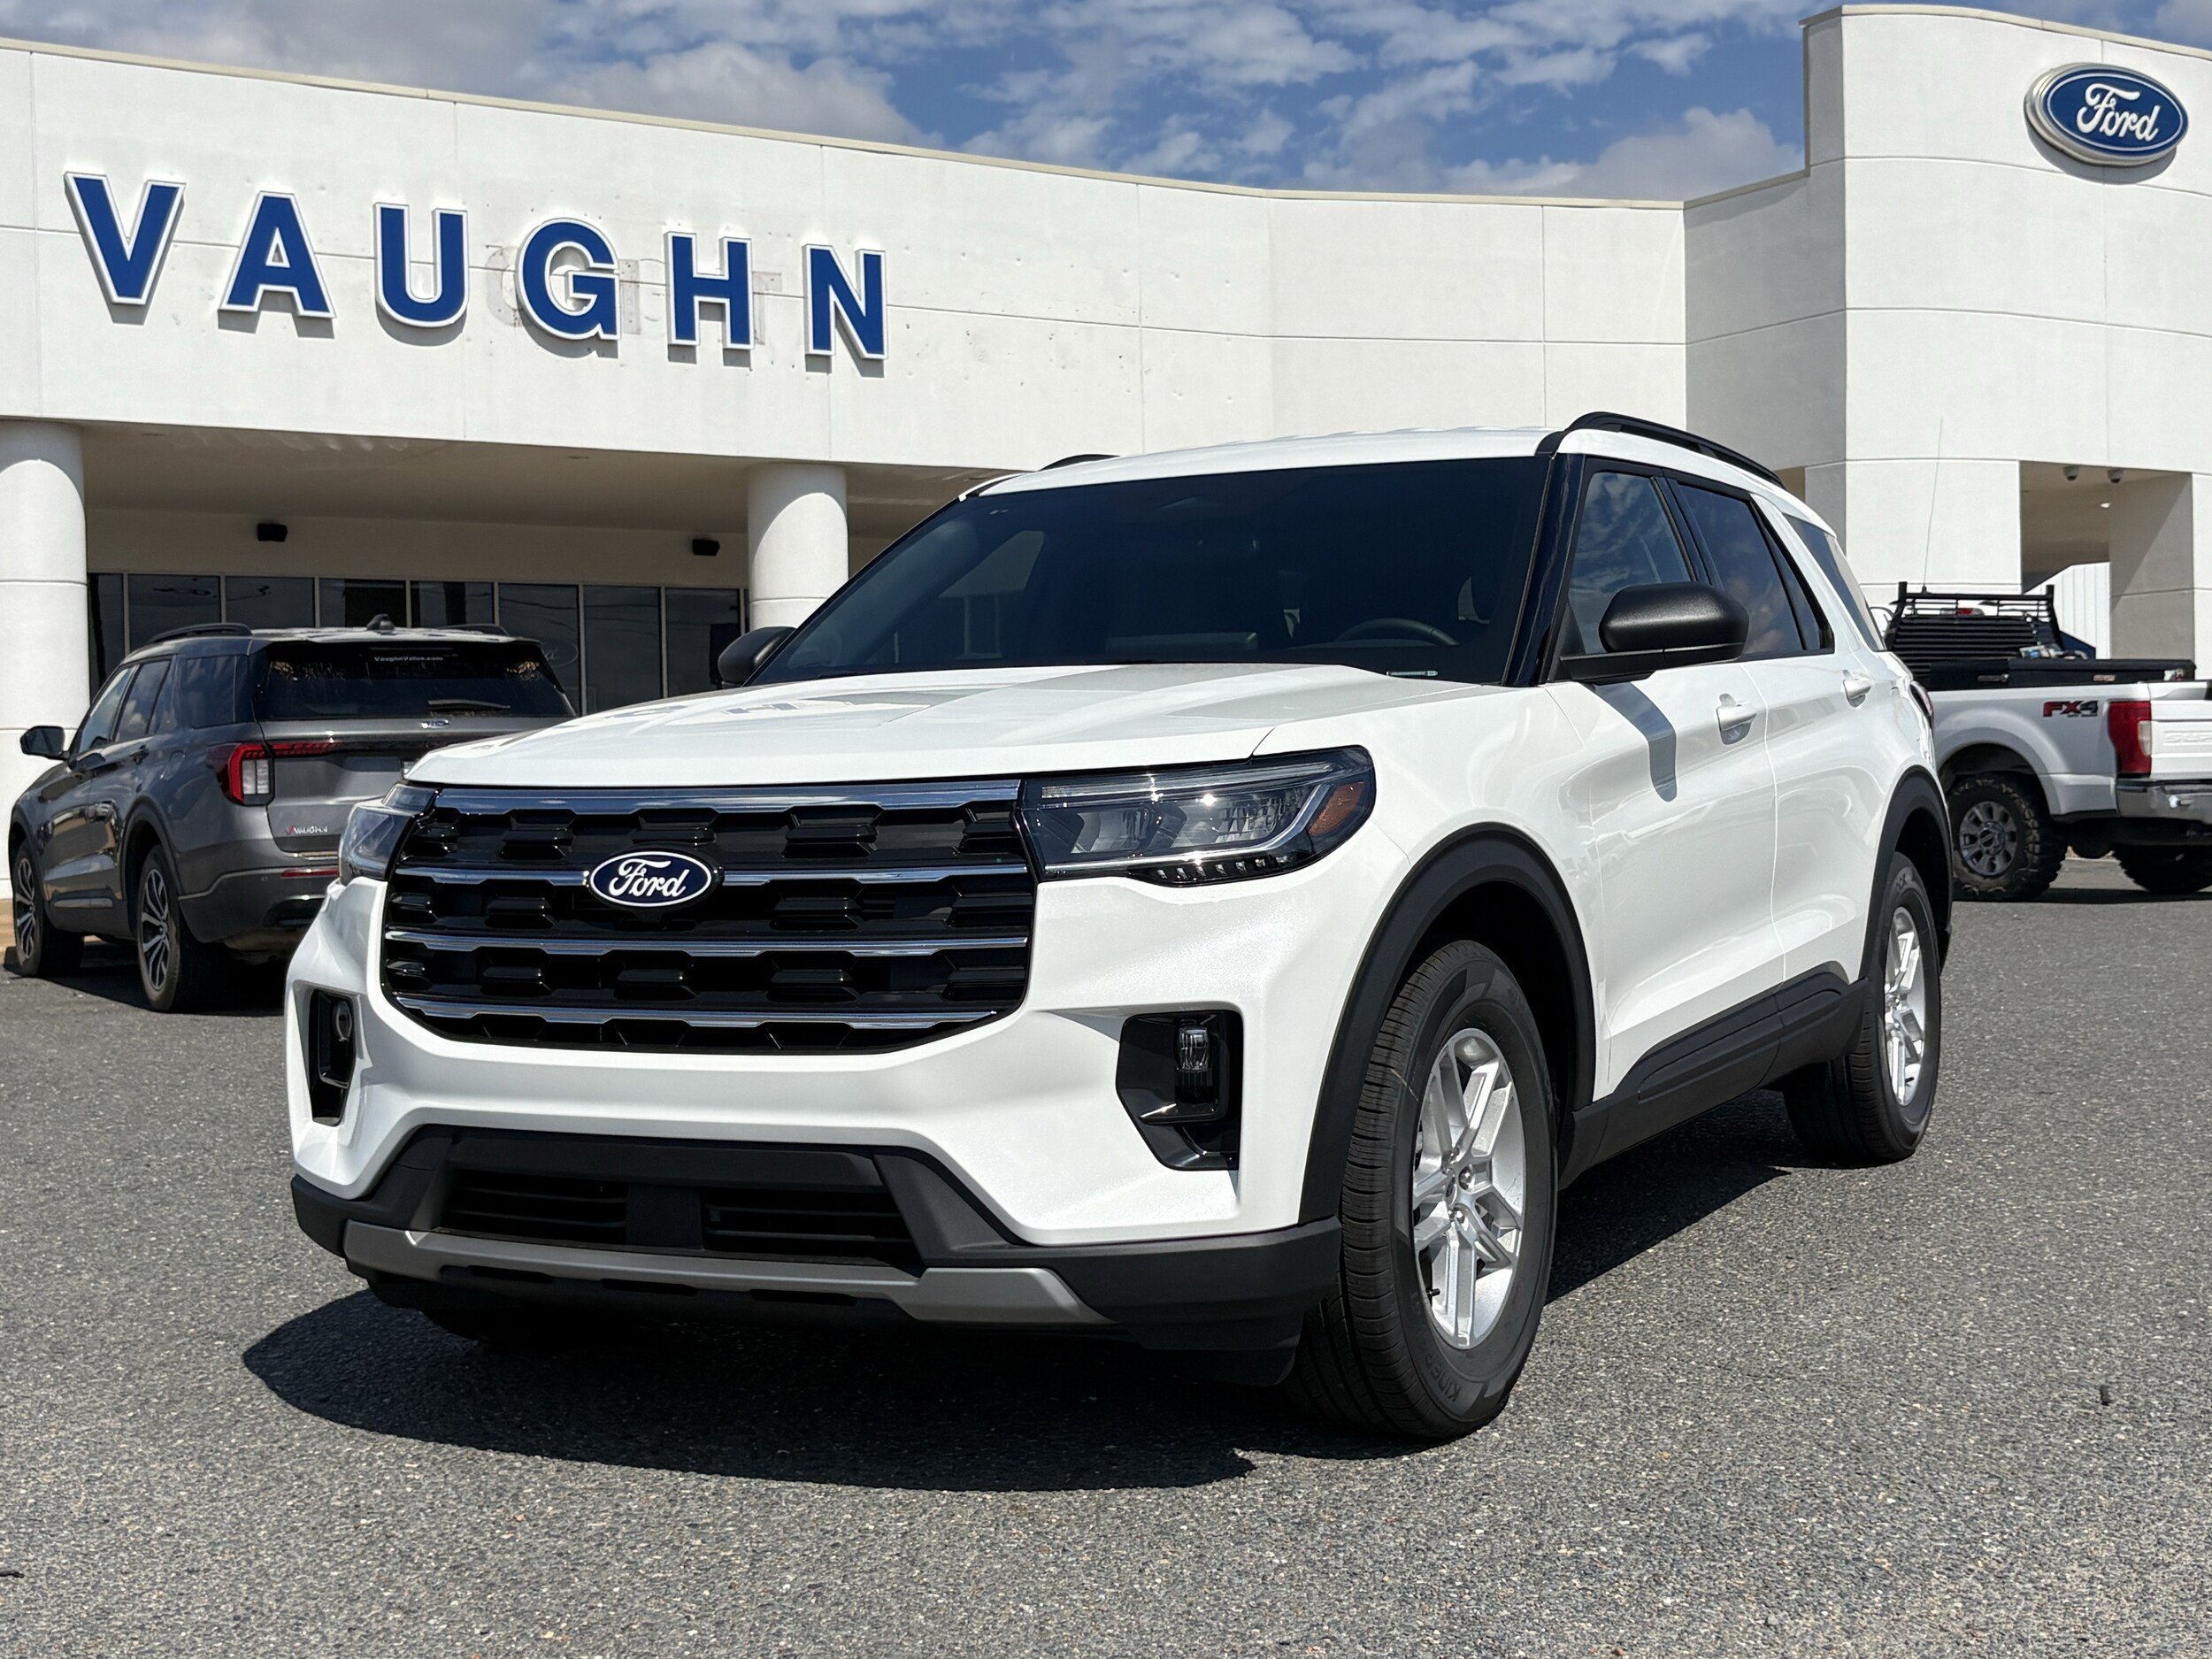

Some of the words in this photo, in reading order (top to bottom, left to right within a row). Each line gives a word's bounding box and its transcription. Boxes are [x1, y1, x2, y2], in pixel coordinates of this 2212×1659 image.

[2076, 82, 2162, 142] Ford
[65, 171, 888, 360] VAUGHN
[2042, 700, 2098, 717] FX4
[608, 857, 690, 897] Ford
